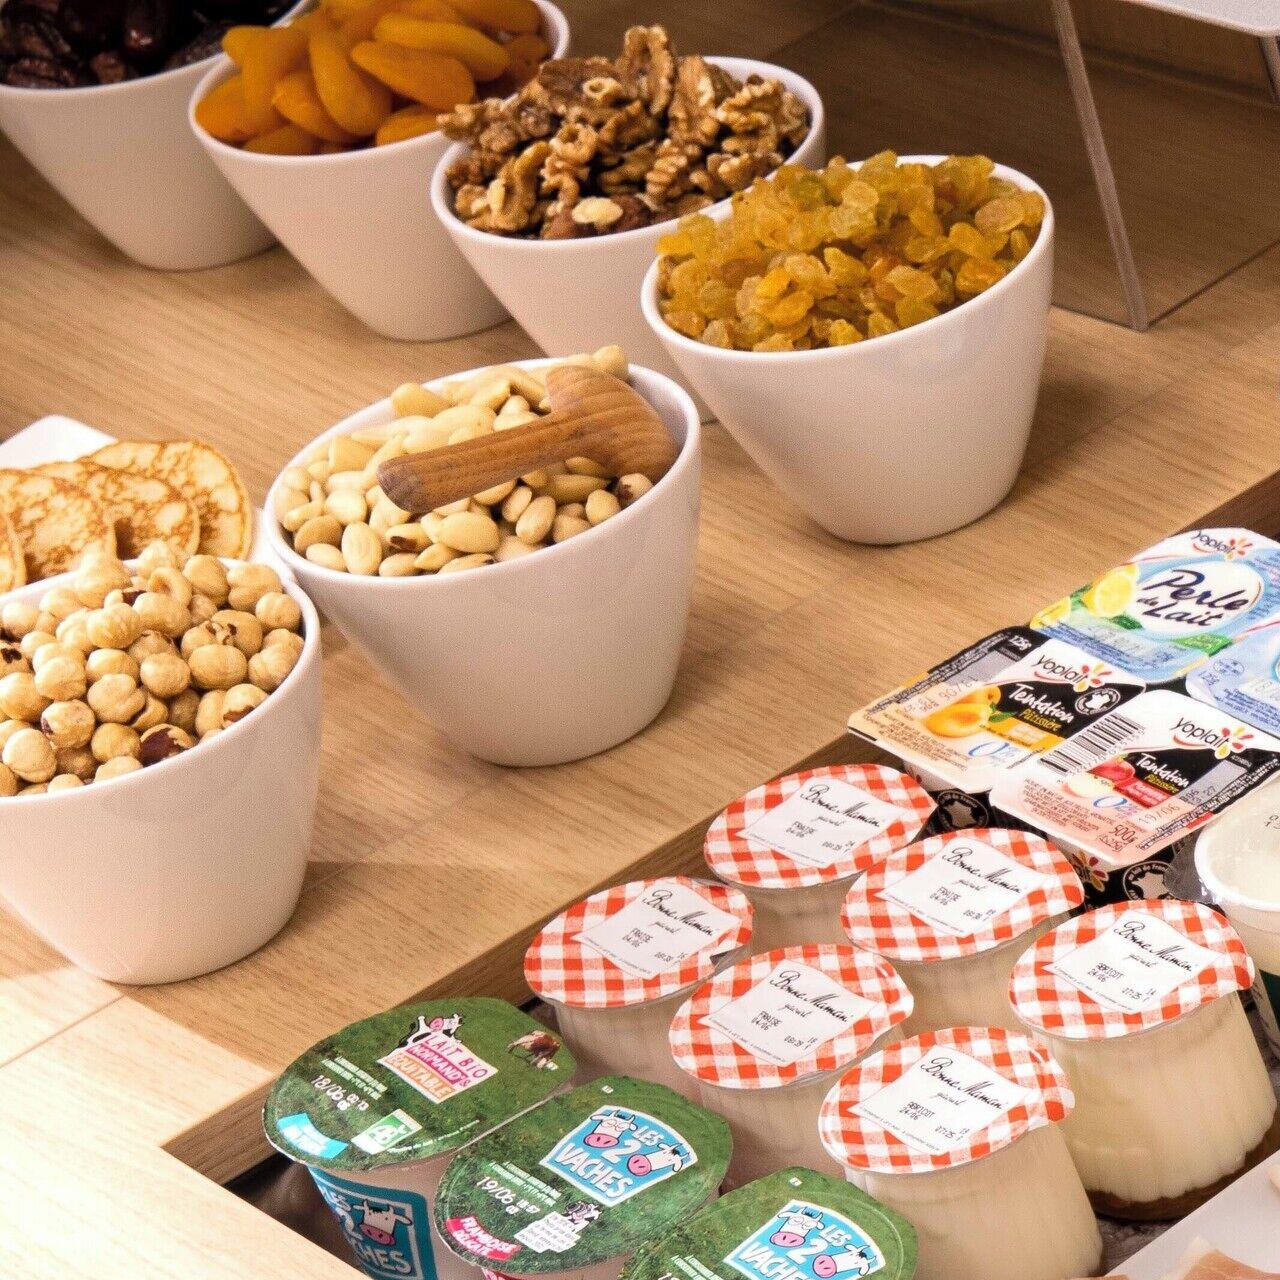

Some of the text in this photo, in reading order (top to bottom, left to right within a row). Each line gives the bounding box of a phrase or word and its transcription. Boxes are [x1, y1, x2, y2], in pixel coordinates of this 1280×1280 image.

[1142, 569, 1250, 612] Perle
[1143, 602, 1225, 627] Lait
[1008, 684, 1075, 725] Tentation
[1135, 753, 1190, 788] Tentation
[800, 784, 836, 813] Bonne
[942, 846, 979, 876] Bonne
[642, 889, 678, 919] Bonne
[1113, 920, 1151, 951] Bonne
[769, 970, 806, 1001] Bonne
[424, 1033, 490, 1079] LAIT BIO
[310, 1074, 344, 1099] 18/06
[920, 1057, 960, 1089] Bonne
[631, 1125, 665, 1147] LES
[602, 1138, 642, 1165] 2
[555, 1143, 635, 1199] VACHES
[476, 1176, 515, 1206] 19/06
[818, 1224, 852, 1247] LES
[790, 1238, 829, 1265] 2
